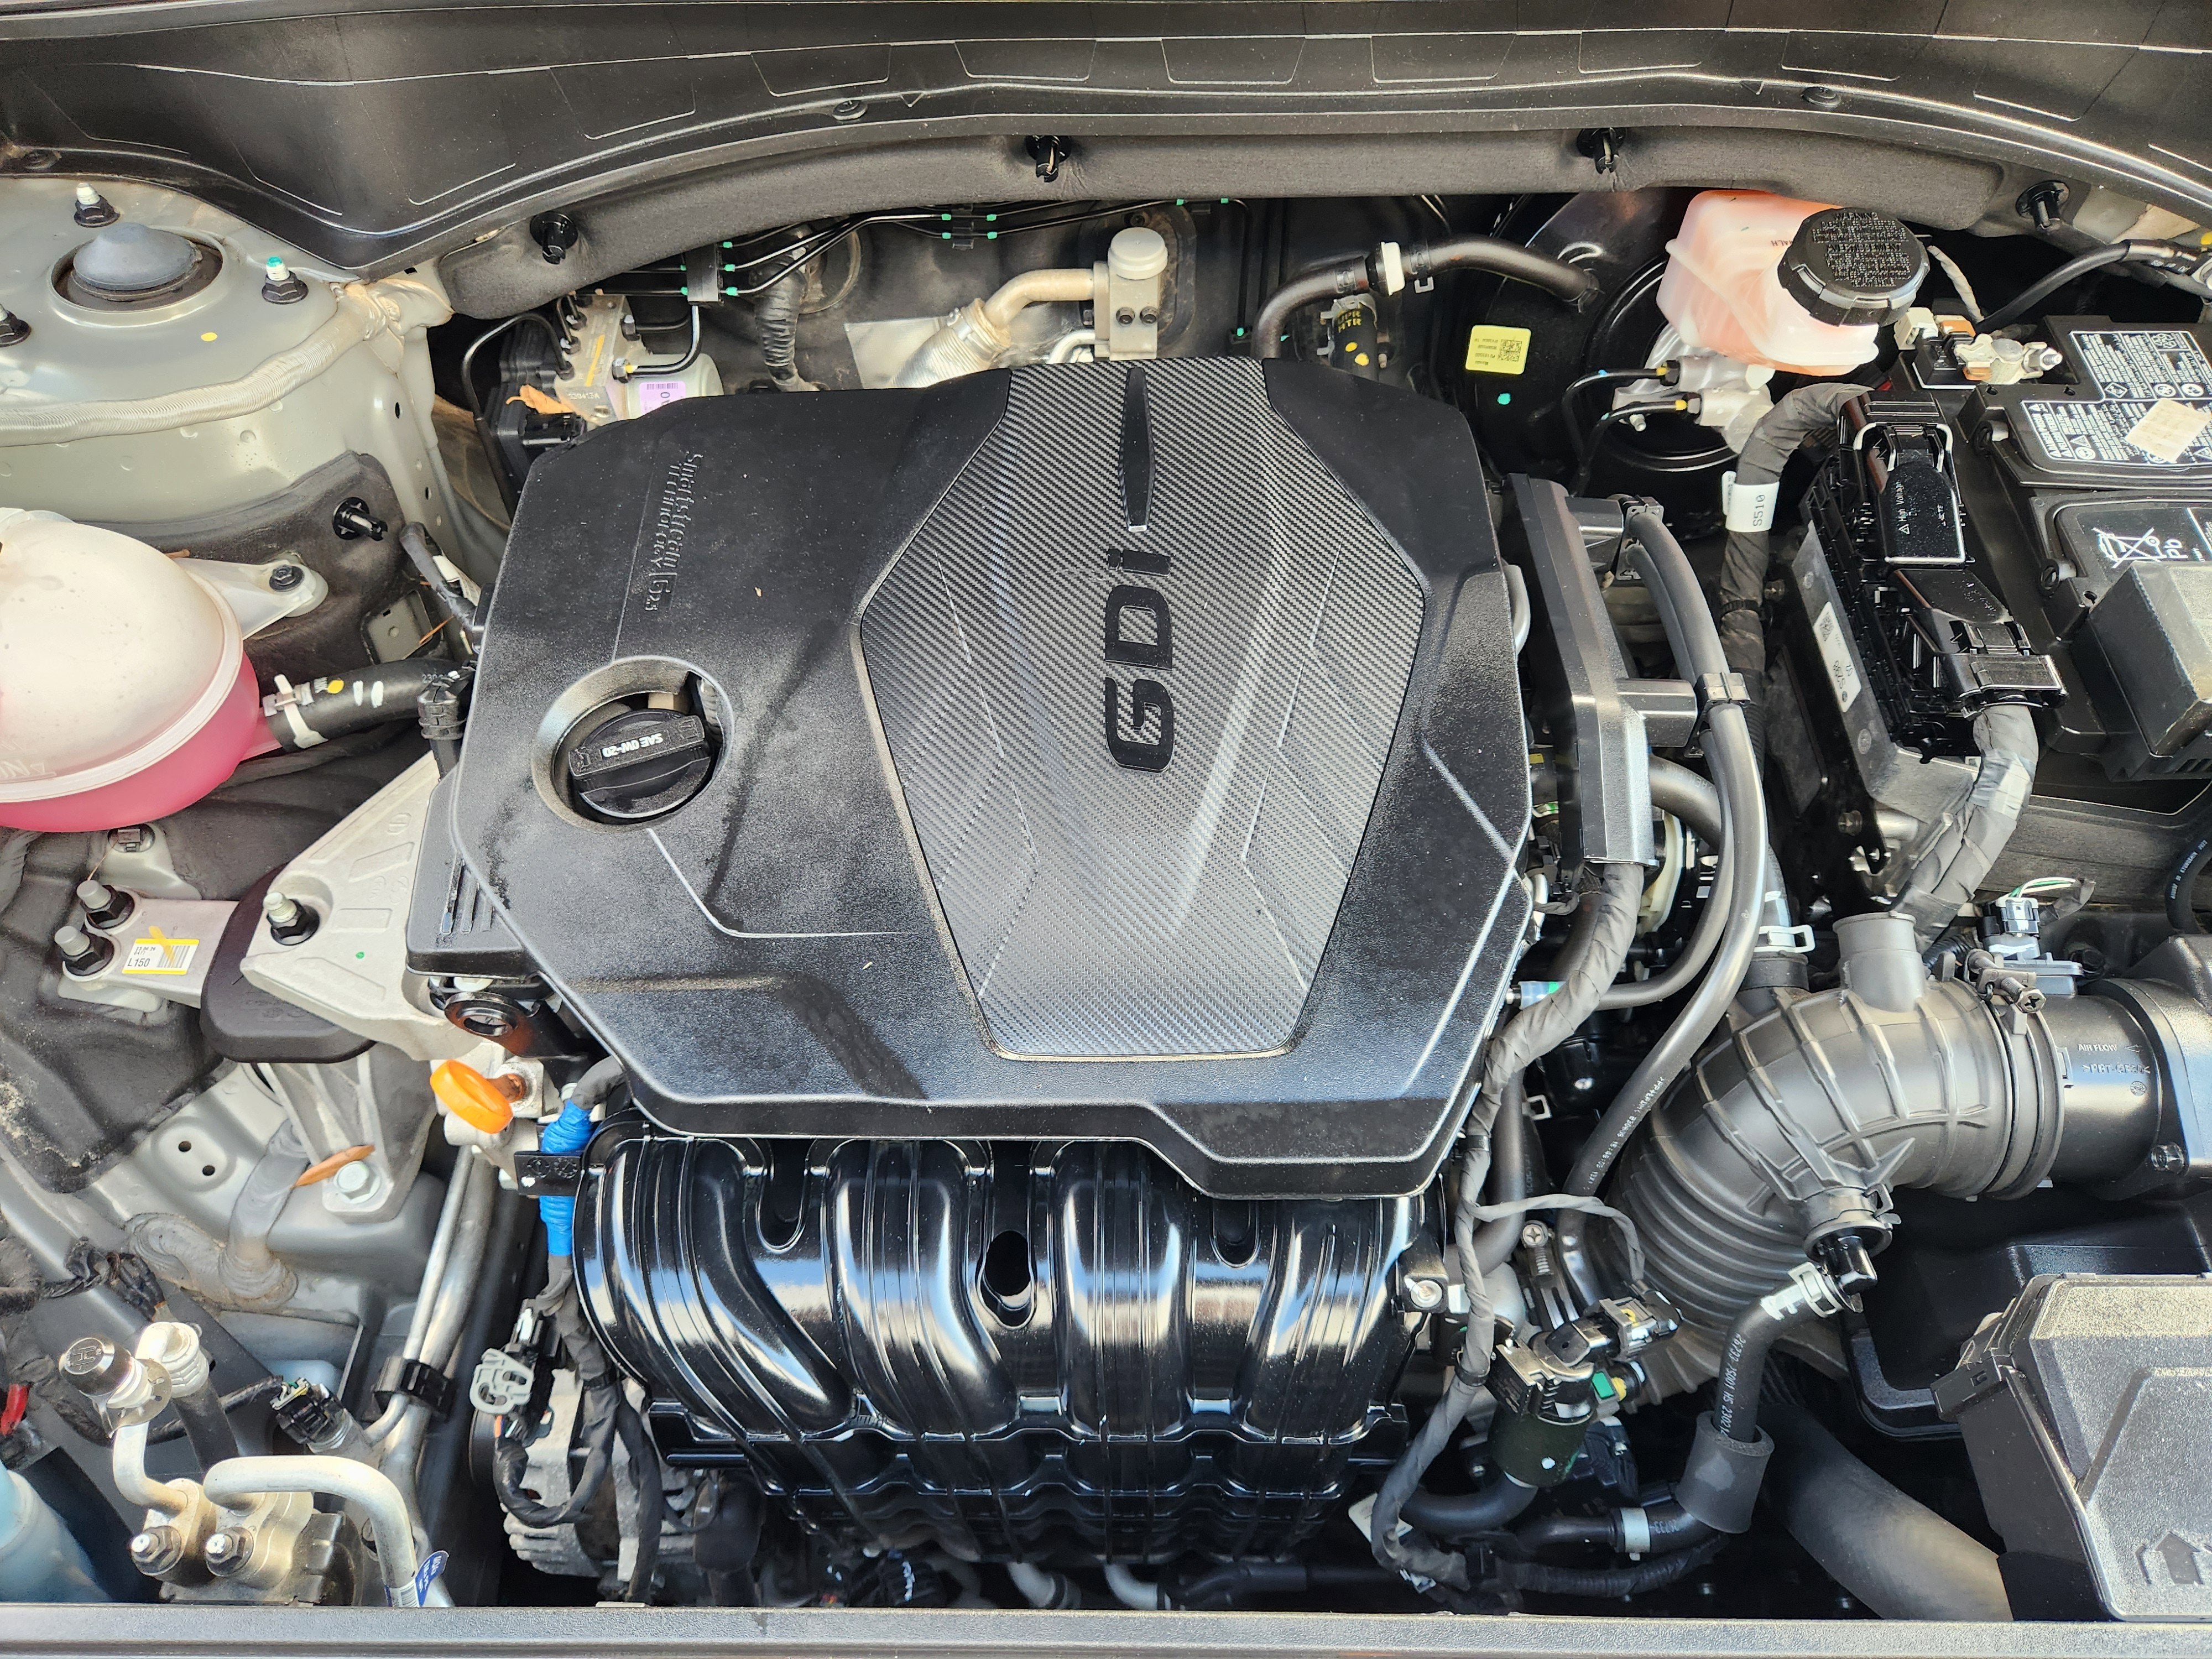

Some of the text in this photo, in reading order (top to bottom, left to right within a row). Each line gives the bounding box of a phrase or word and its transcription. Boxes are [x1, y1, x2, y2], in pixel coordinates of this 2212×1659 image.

[1338, 318, 1361, 333] HTR
[1752, 494, 1765, 527] S510
[1897, 508, 1908, 522] High
[2163, 539, 2189, 559] Pb
[1104, 548, 1176, 775] GDi
[602, 733, 664, 758] SAE 0W-20
[127, 958, 151, 967] L150
[2078, 1044, 2118, 1052] AIR FLOW
[1724, 1391, 1735, 1404] HS
